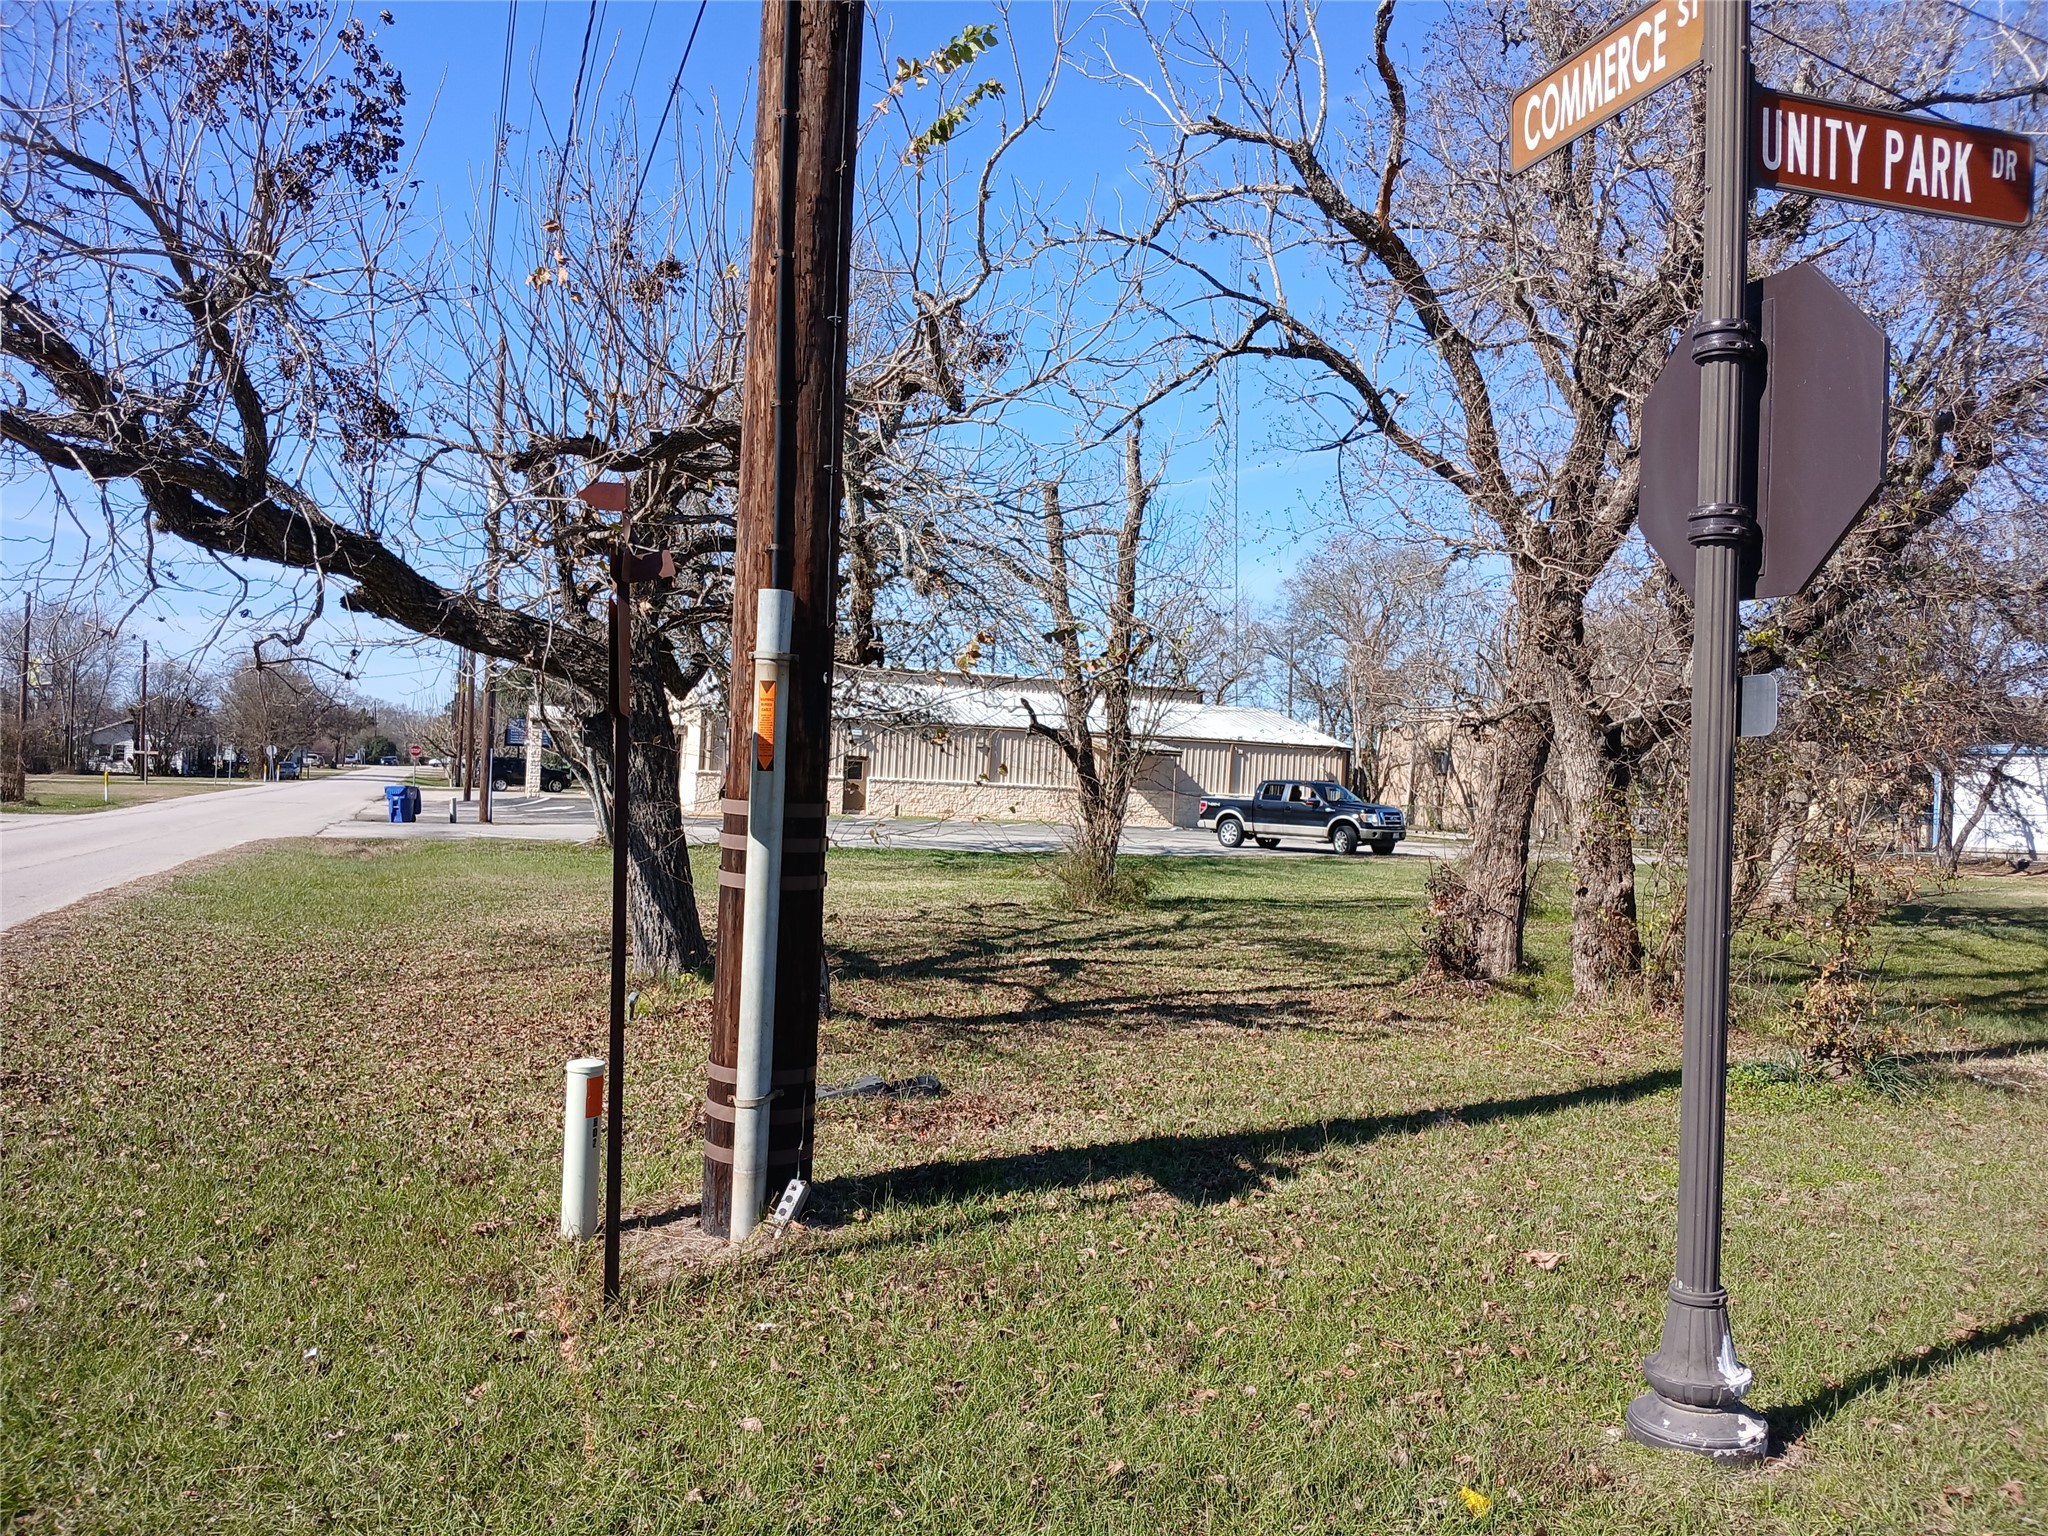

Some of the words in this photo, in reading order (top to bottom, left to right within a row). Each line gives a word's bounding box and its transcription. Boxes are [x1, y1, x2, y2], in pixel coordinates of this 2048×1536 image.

[1524, 8, 1667, 150] COMMERCE
[1677, 0, 1698, 27] ST
[1762, 106, 1867, 185] UNITY
[1884, 128, 1974, 204] PARK
[1991, 147, 2018, 181] DR
